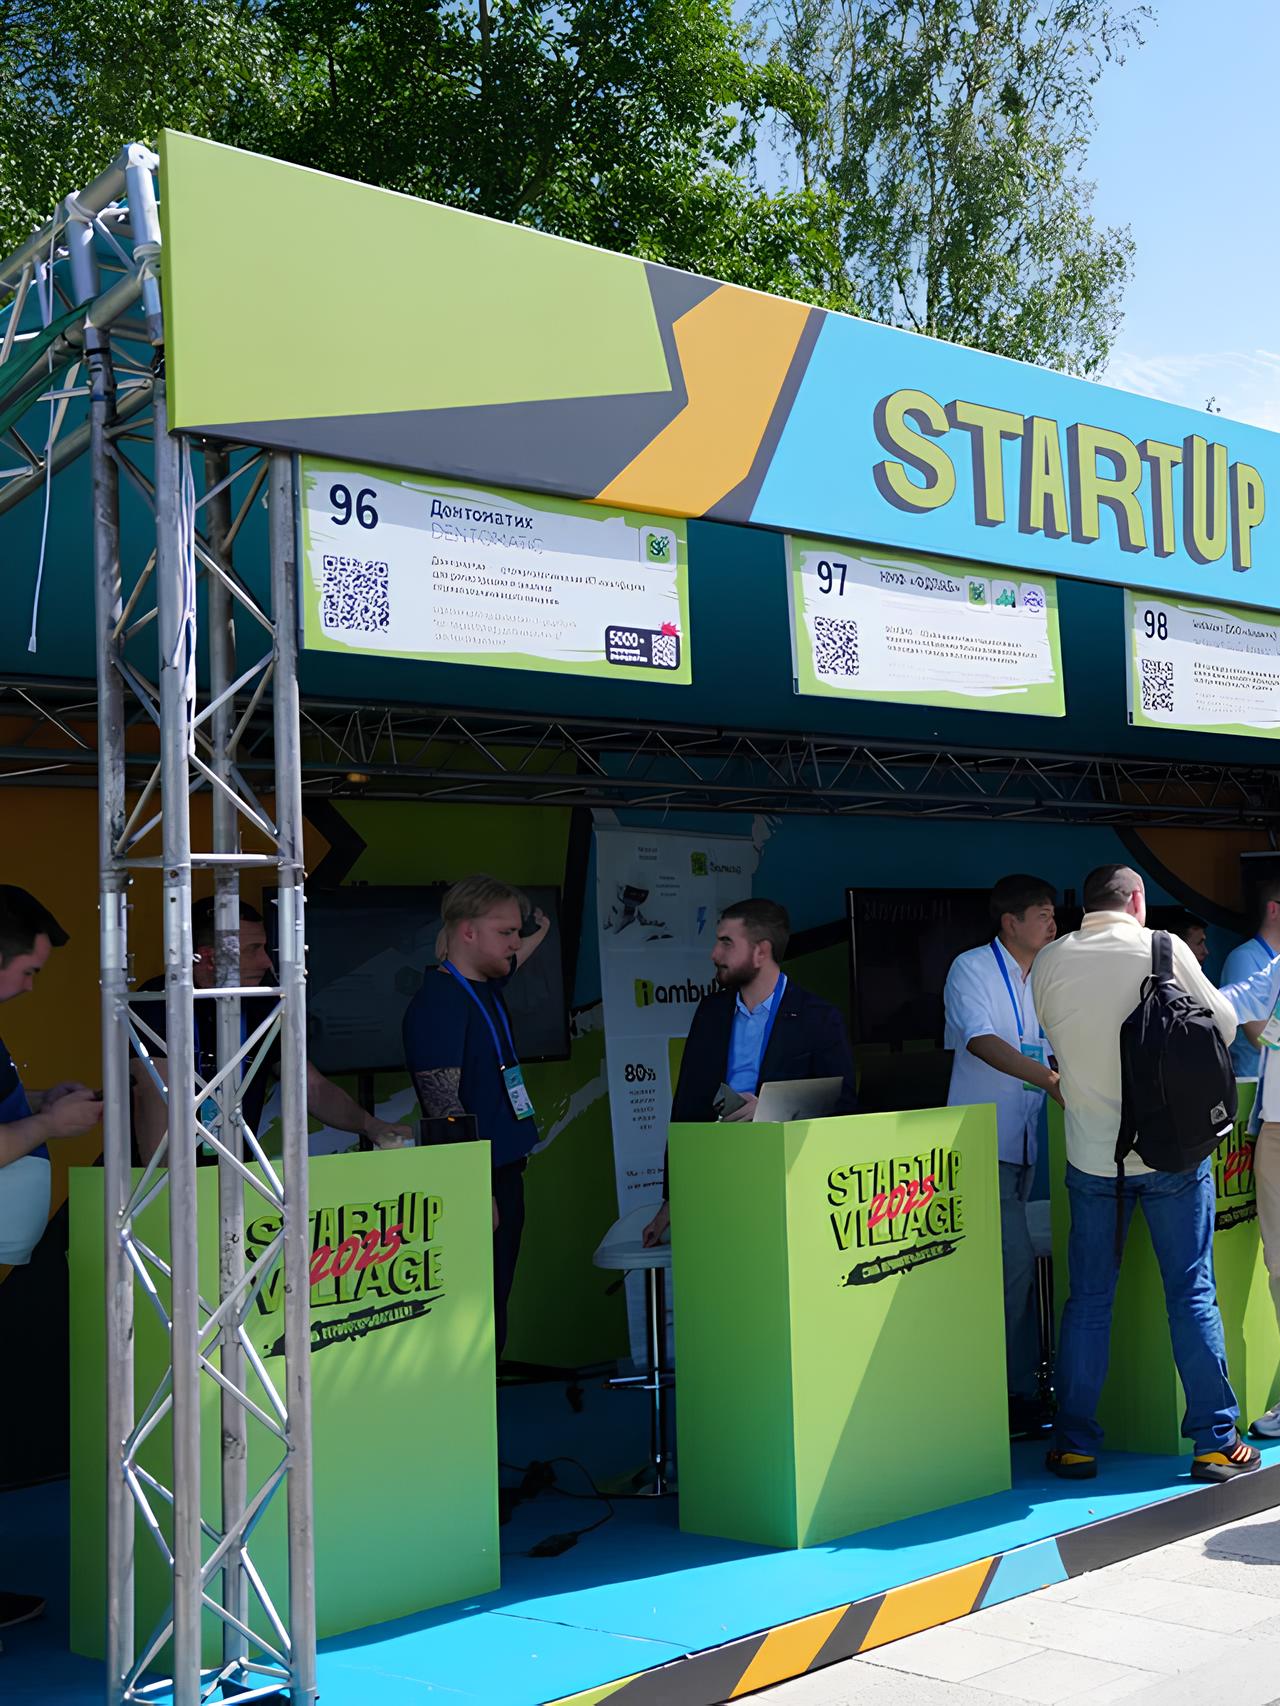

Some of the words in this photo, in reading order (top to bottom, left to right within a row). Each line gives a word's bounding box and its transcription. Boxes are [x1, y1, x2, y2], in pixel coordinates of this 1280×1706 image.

[329, 483, 379, 530] 96
[873, 388, 1265, 573] STARTUP
[817, 560, 848, 596] 97
[1144, 610, 1168, 641] 98
[827, 1147, 962, 1207] STARTUP
[867, 1174, 935, 1229] 2025
[246, 1191, 444, 1265] SARTUP
[830, 1195, 964, 1251] VILLAGE
[250, 1246, 446, 1316] VLLAGE
[309, 1223, 404, 1286] 2025
